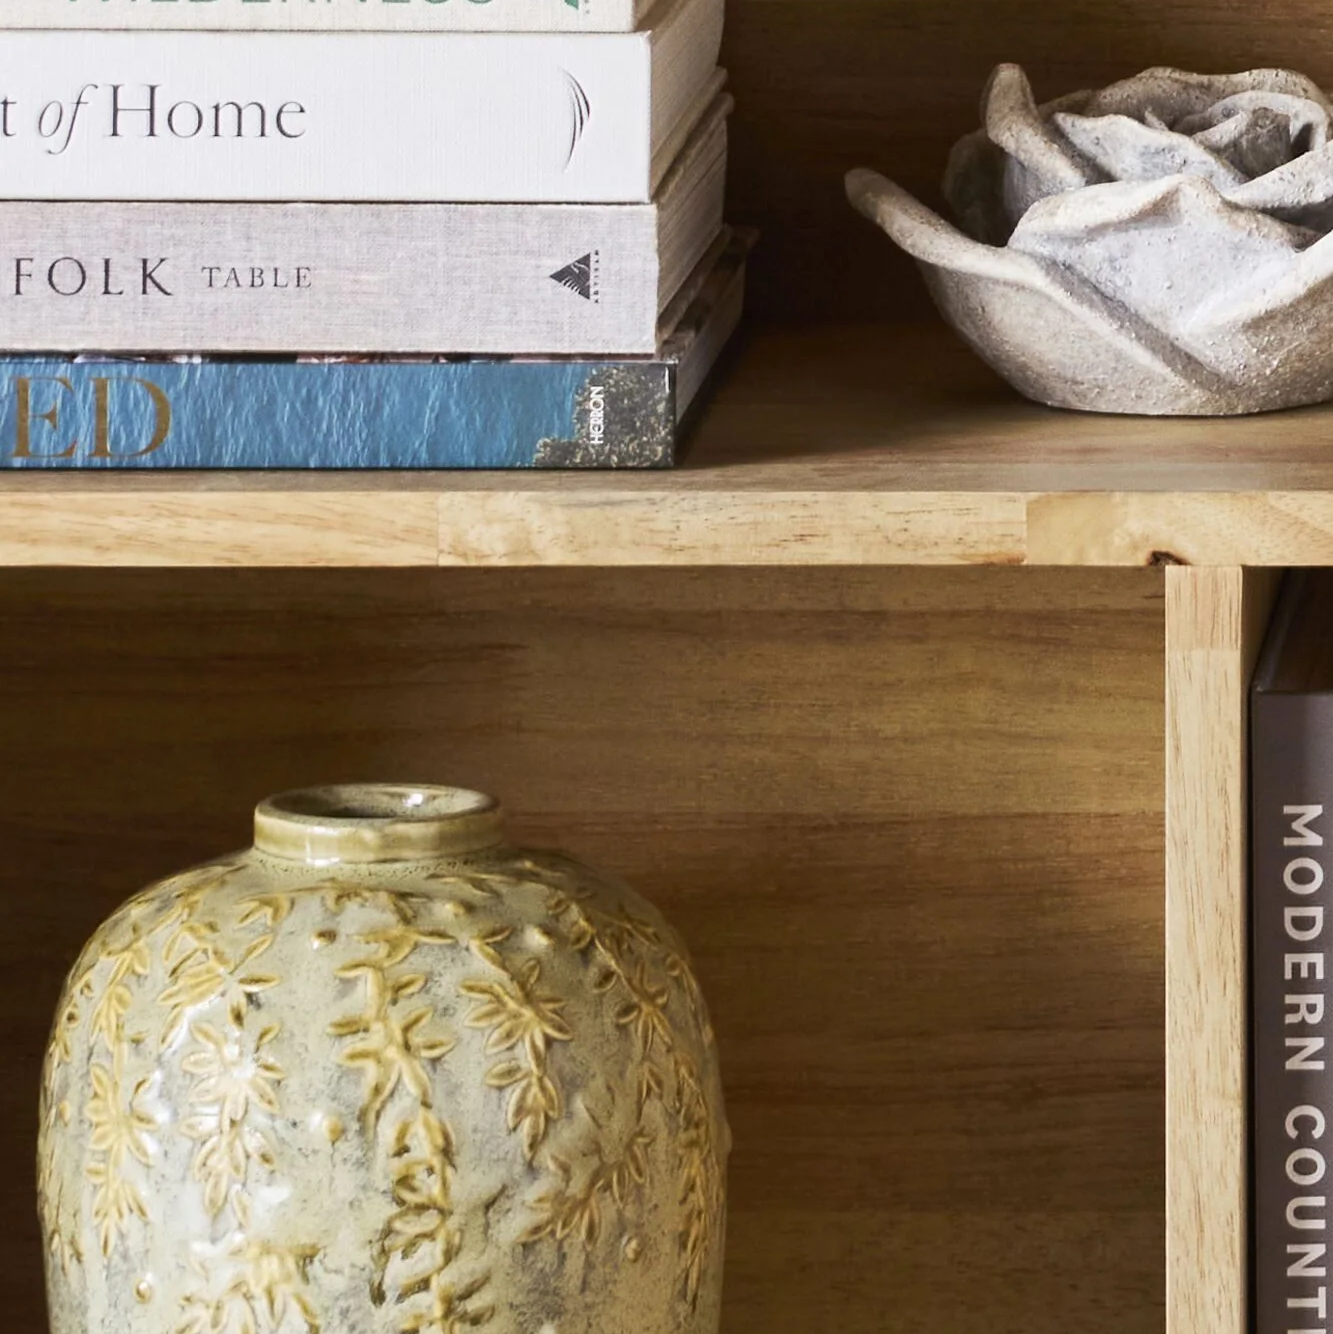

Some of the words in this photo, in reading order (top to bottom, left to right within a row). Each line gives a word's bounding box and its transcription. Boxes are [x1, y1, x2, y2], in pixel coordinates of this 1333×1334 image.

[37, 83, 99, 155] of
[109, 83, 306, 139] Home
[14, 256, 174, 297] FOLK
[201, 266, 312, 289] TABLE
[10, 376, 172, 458] ED
[589, 385, 605, 445] HERRON
[1282, 804, 1326, 1072] MODERN
